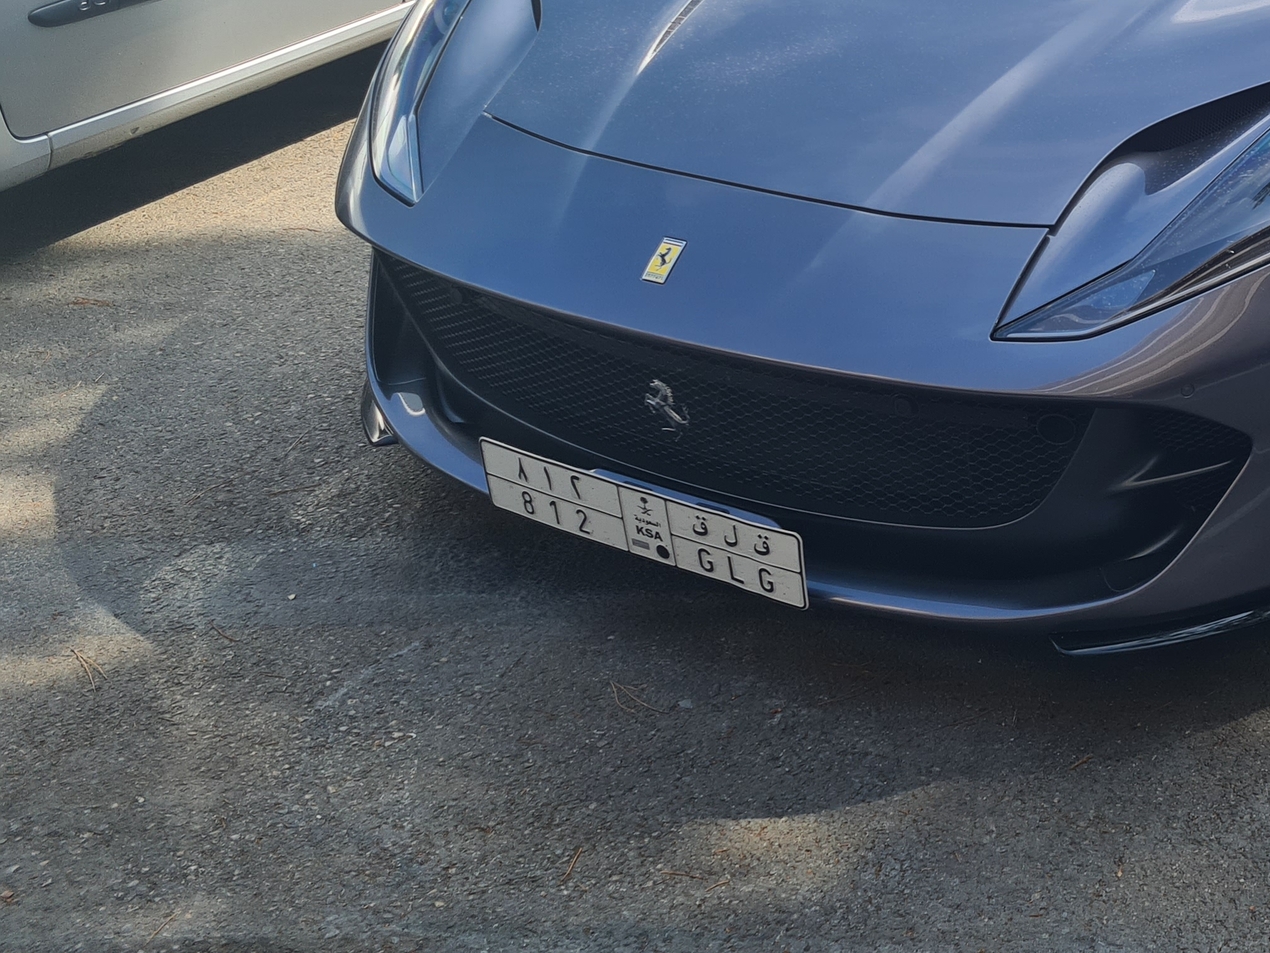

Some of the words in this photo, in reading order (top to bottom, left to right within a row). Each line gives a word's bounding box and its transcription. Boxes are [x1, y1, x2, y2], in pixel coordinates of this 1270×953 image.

[521, 491, 591, 534] 812
[697, 548, 774, 593] GLG
[635, 525, 664, 542] KSA
